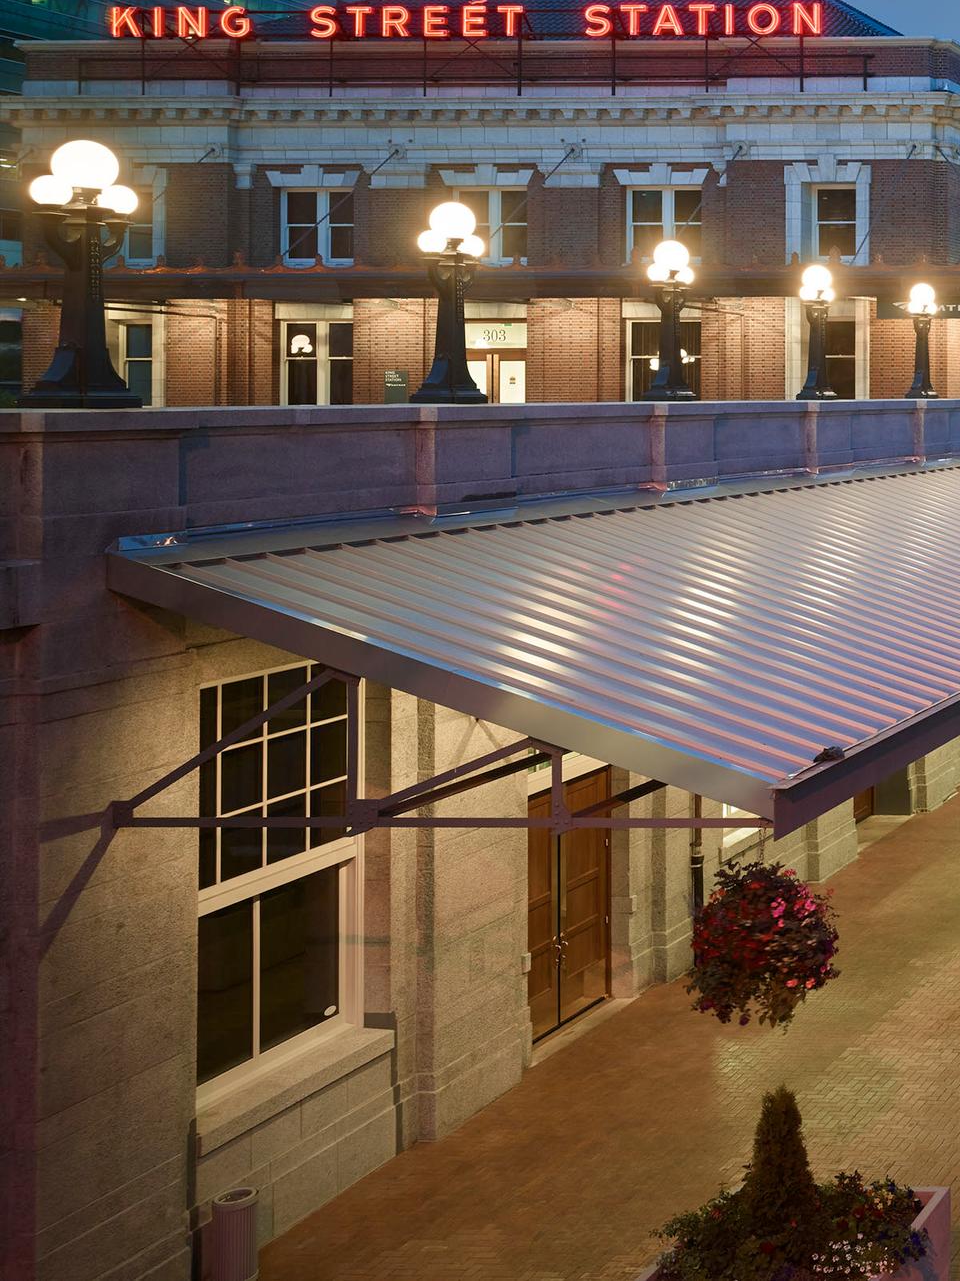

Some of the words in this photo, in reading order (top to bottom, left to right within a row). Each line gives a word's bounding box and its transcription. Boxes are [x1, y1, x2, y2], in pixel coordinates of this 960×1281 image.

[111, 6, 251, 38] KING
[309, 5, 524, 39] STREET
[584, 2, 823, 38] STATION
[483, 329, 506, 342] 303
